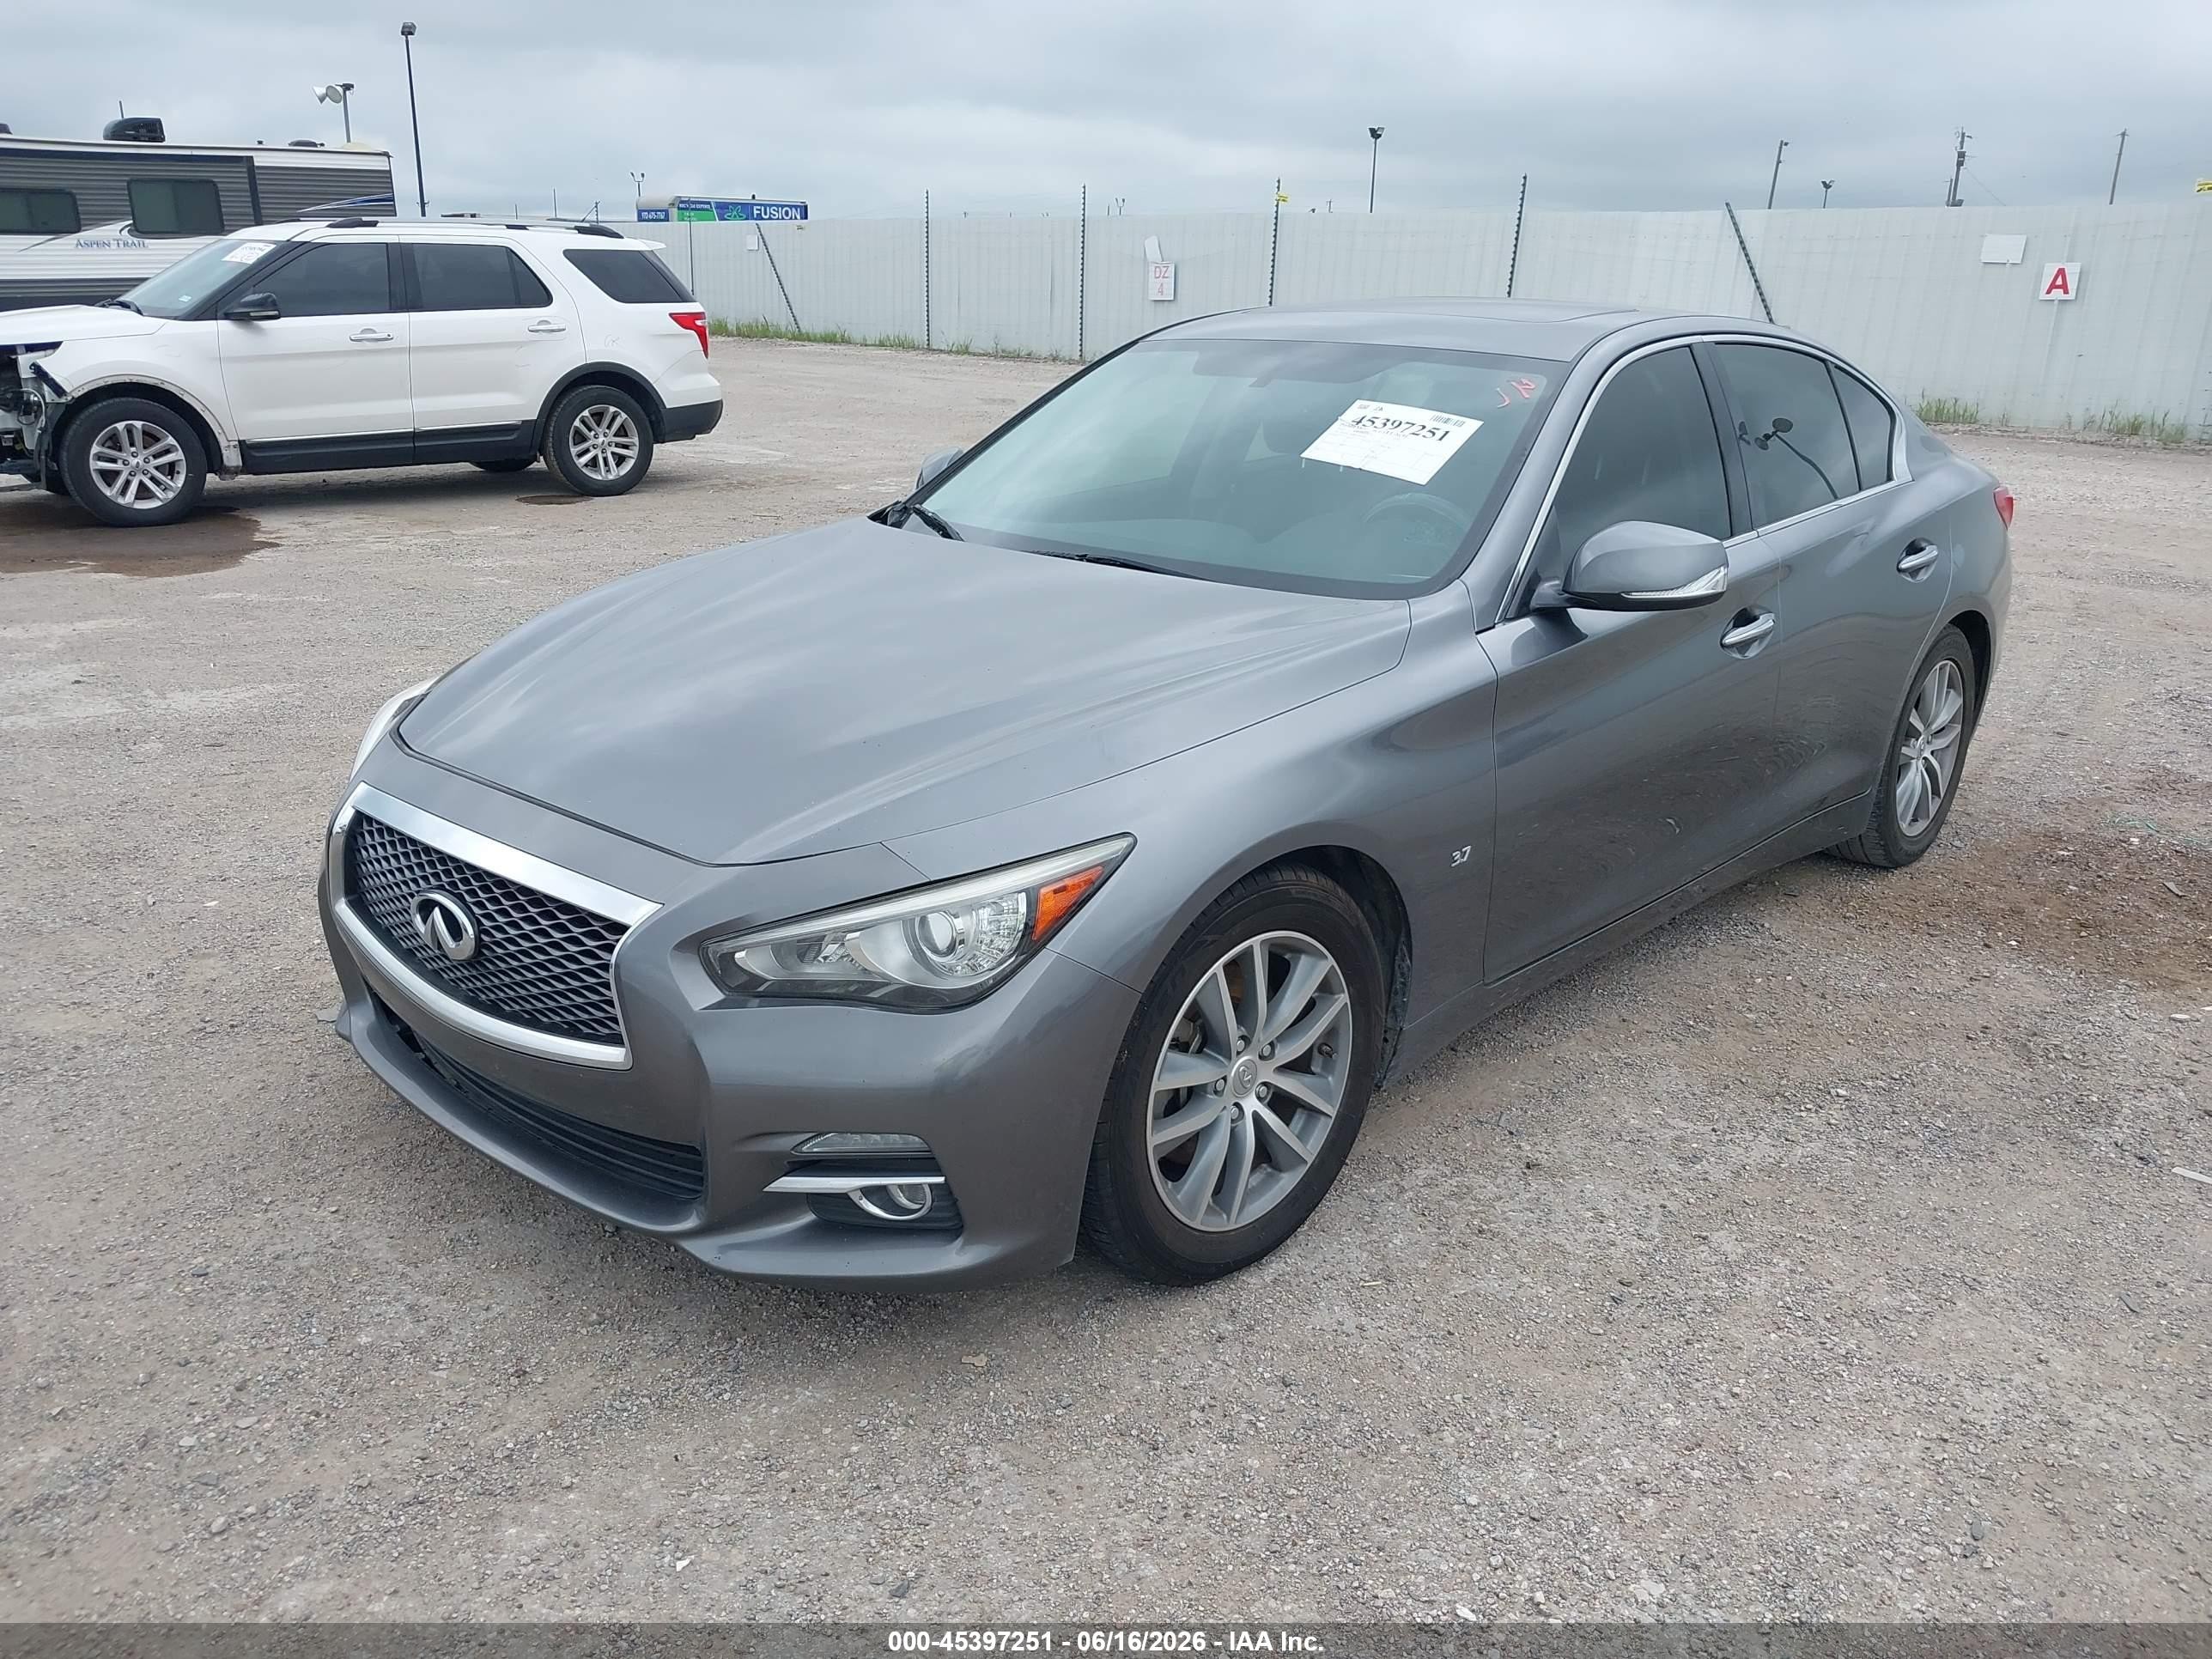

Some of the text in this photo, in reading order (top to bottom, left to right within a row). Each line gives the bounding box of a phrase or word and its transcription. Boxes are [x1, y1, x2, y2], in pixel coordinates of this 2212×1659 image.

[753, 205, 801, 221] FUSION
[76, 238, 149, 248] ASPEN TRAIL
[1153, 265, 1170, 279] DZ
[2045, 267, 2070, 295] A
[1158, 282, 1164, 296] 4
[1351, 415, 1450, 441] 45397251
